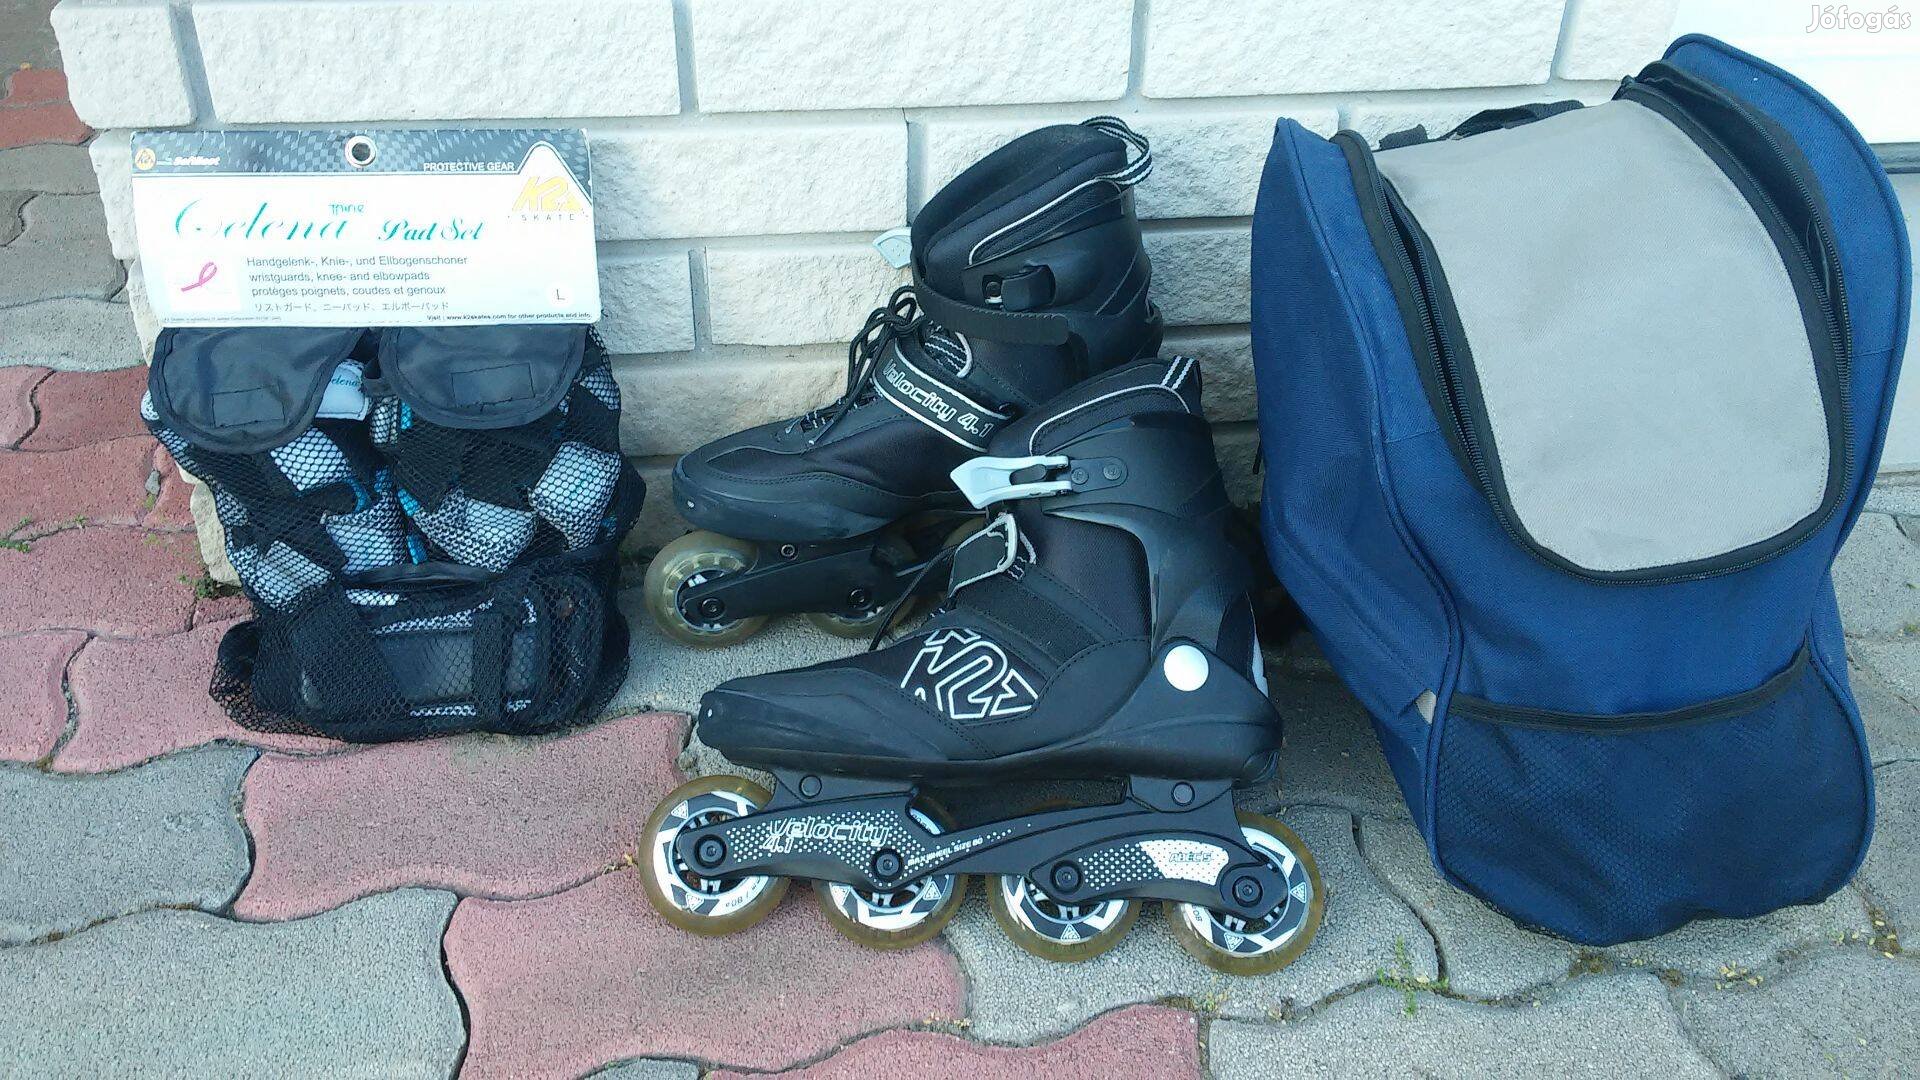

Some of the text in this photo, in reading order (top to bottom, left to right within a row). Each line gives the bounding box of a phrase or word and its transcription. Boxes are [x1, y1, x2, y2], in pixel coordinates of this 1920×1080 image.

[423, 162, 515, 172] PROTECTIVE GEAR
[521, 214, 574, 222] SKATE
[378, 217, 438, 241] Pad
[246, 255, 467, 269] Handgelenk-, Knie-, und Ellbogenschoner
[249, 271, 430, 284] wristguards, knee- and elbowpads
[301, 286, 349, 298] poignets,
[352, 286, 391, 295] coudes
[394, 285, 404, 295] et
[406, 287, 446, 297] genoux
[556, 288, 566, 301] L
[566, 311, 578, 319] and
[882, 359, 994, 438] Velocity 4.1
[768, 815, 890, 848] Velocity
[761, 835, 795, 854] 4.1
[925, 846, 953, 861] WHEEL
[953, 840, 972, 853] SIZE
